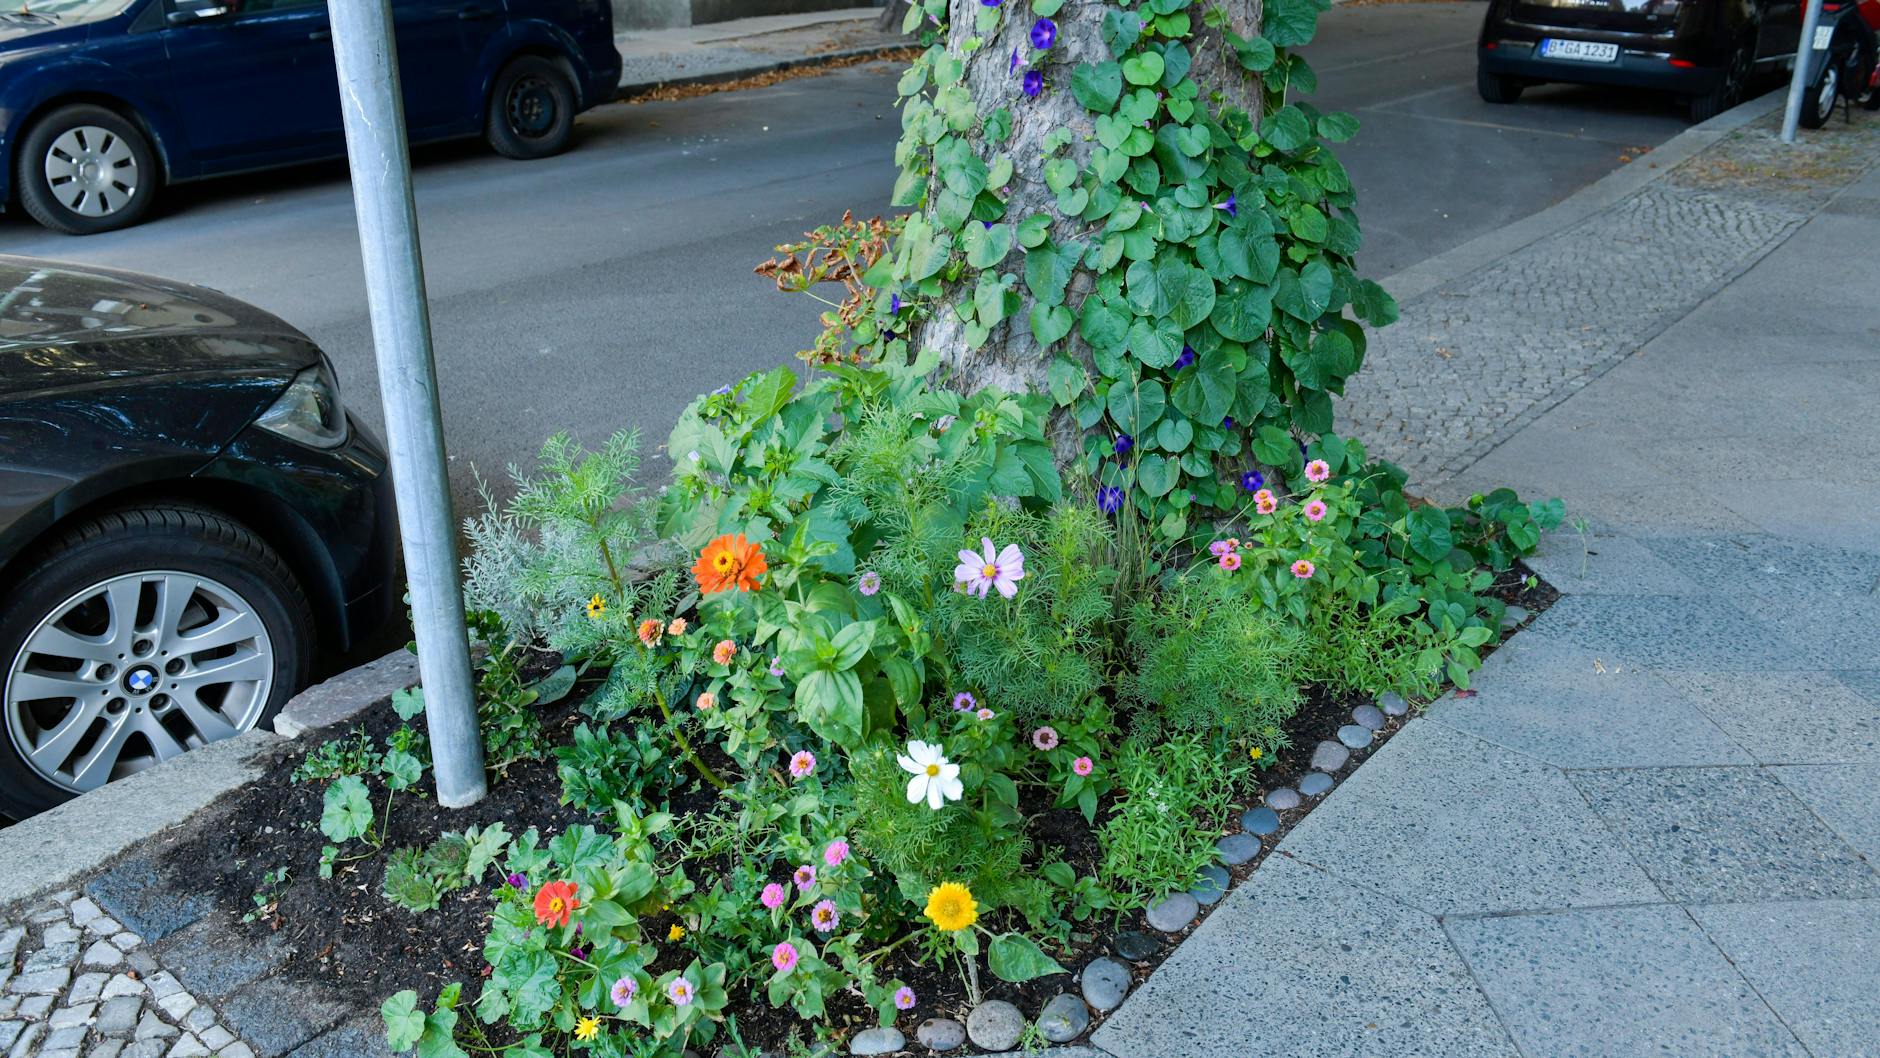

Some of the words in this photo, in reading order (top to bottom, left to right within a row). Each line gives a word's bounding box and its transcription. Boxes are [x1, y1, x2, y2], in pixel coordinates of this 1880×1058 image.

[1549, 41, 1556, 52] B
[1564, 42, 1580, 54] GA
[1584, 44, 1614, 58] 1231
